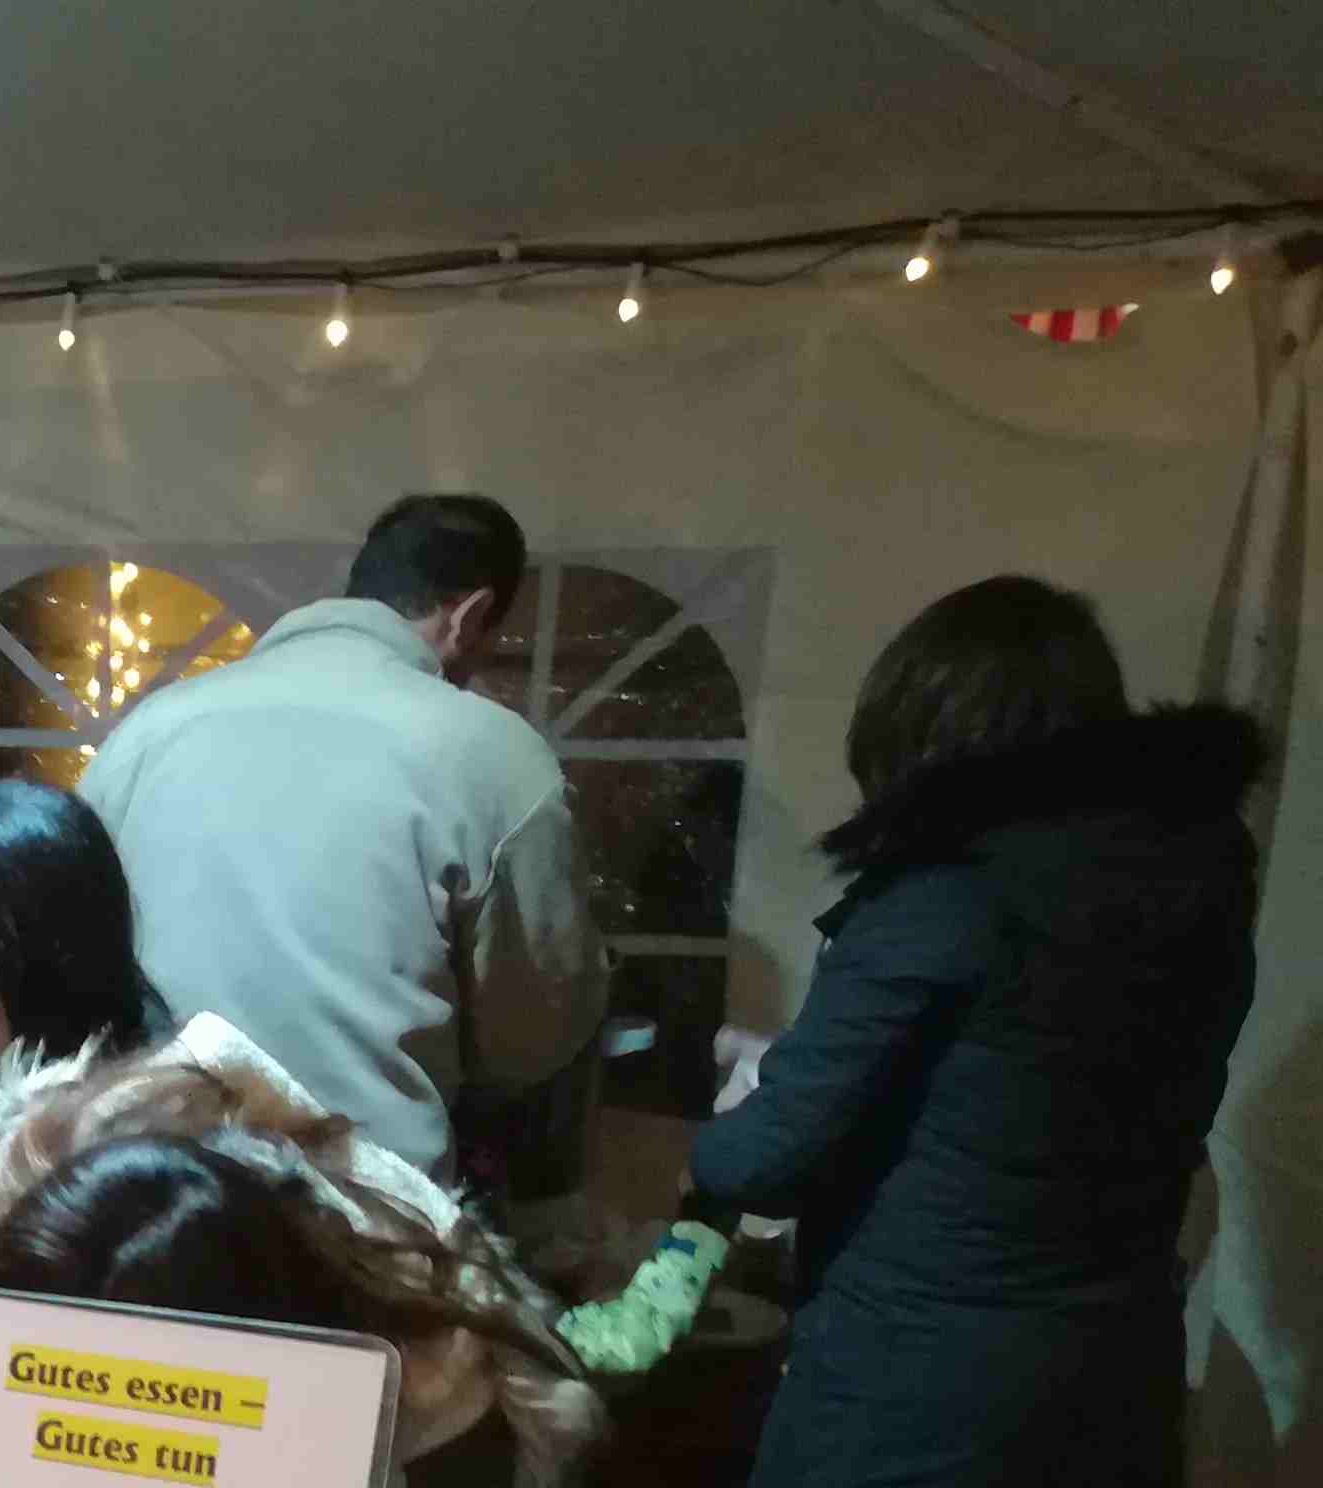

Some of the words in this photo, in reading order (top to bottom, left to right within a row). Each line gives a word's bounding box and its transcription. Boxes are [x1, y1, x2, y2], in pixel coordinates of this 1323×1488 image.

[9, 1352, 111, 1395] Gutes
[126, 1376, 224, 1412] essen
[36, 1419, 139, 1464] Gutes
[156, 1444, 218, 1478] tun
